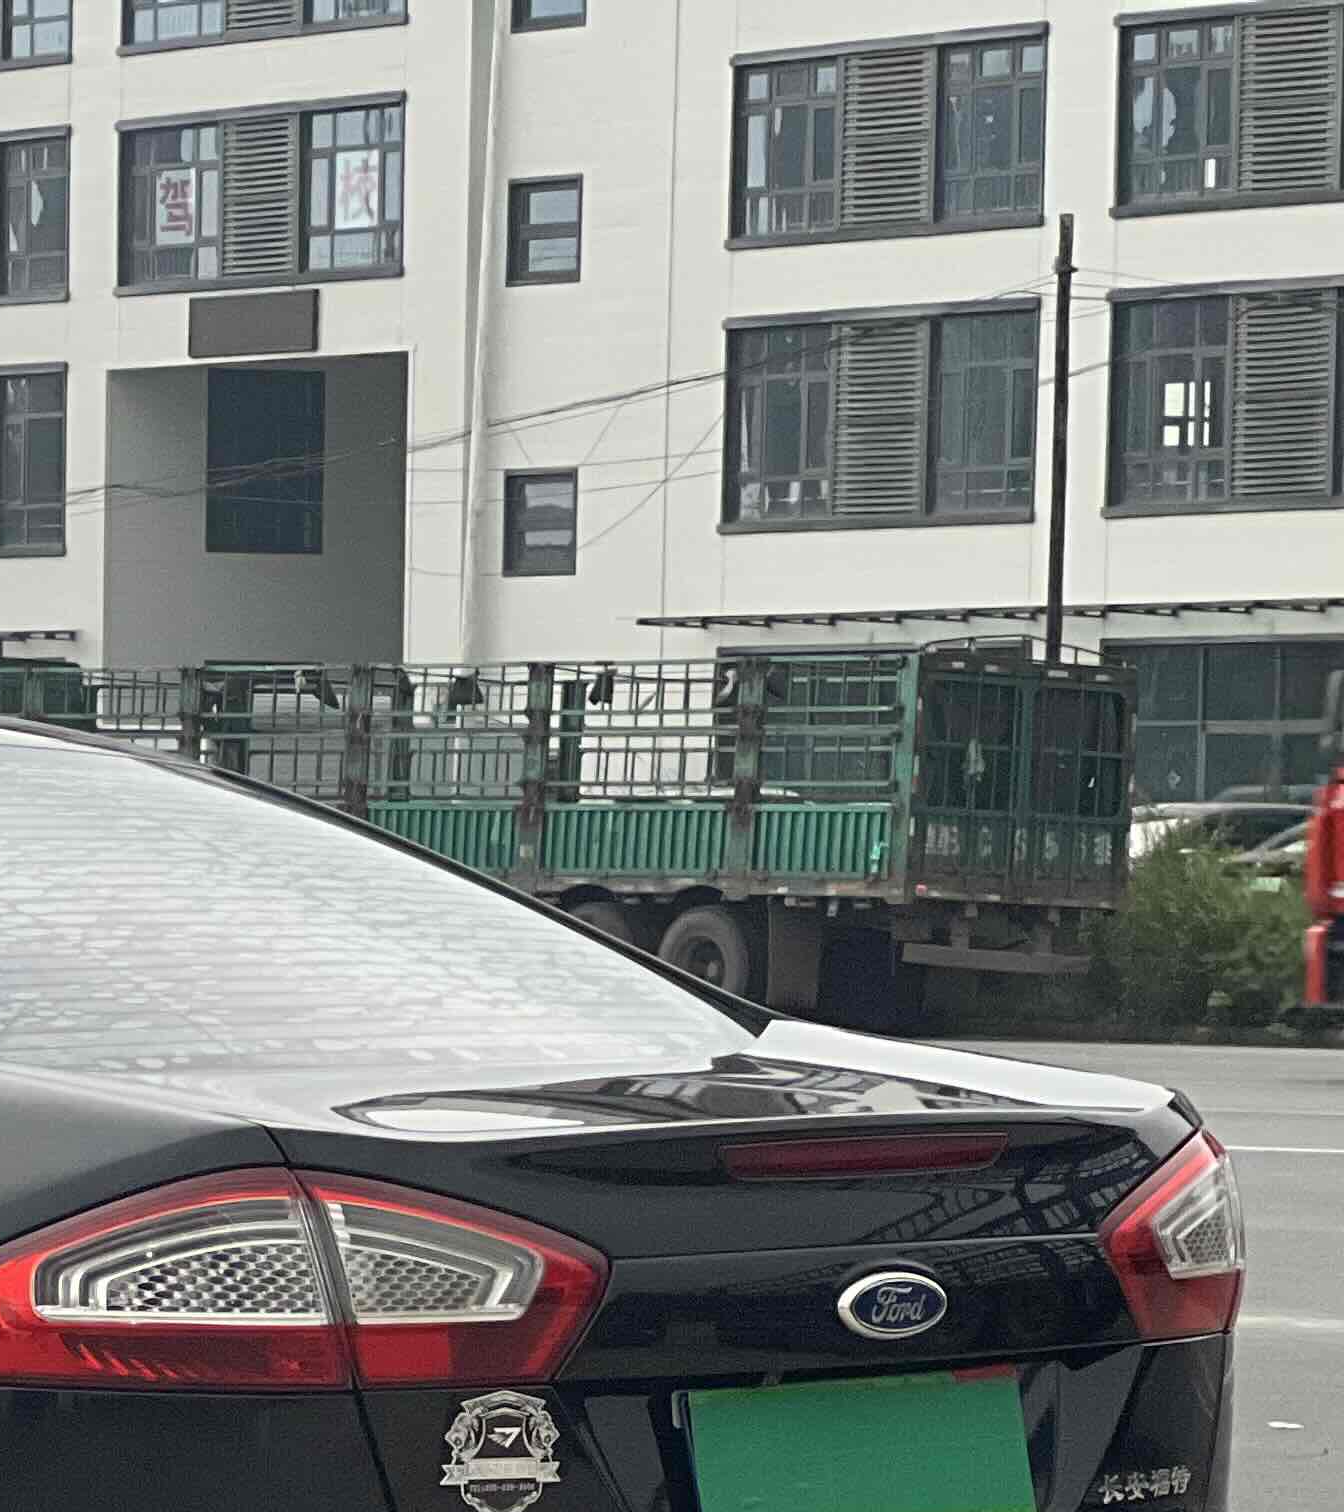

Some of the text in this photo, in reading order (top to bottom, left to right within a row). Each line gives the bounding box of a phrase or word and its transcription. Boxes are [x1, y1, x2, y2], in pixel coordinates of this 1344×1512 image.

[872, 1286, 928, 1323] Ford
[1098, 1465, 1192, 1504] 长安福特
